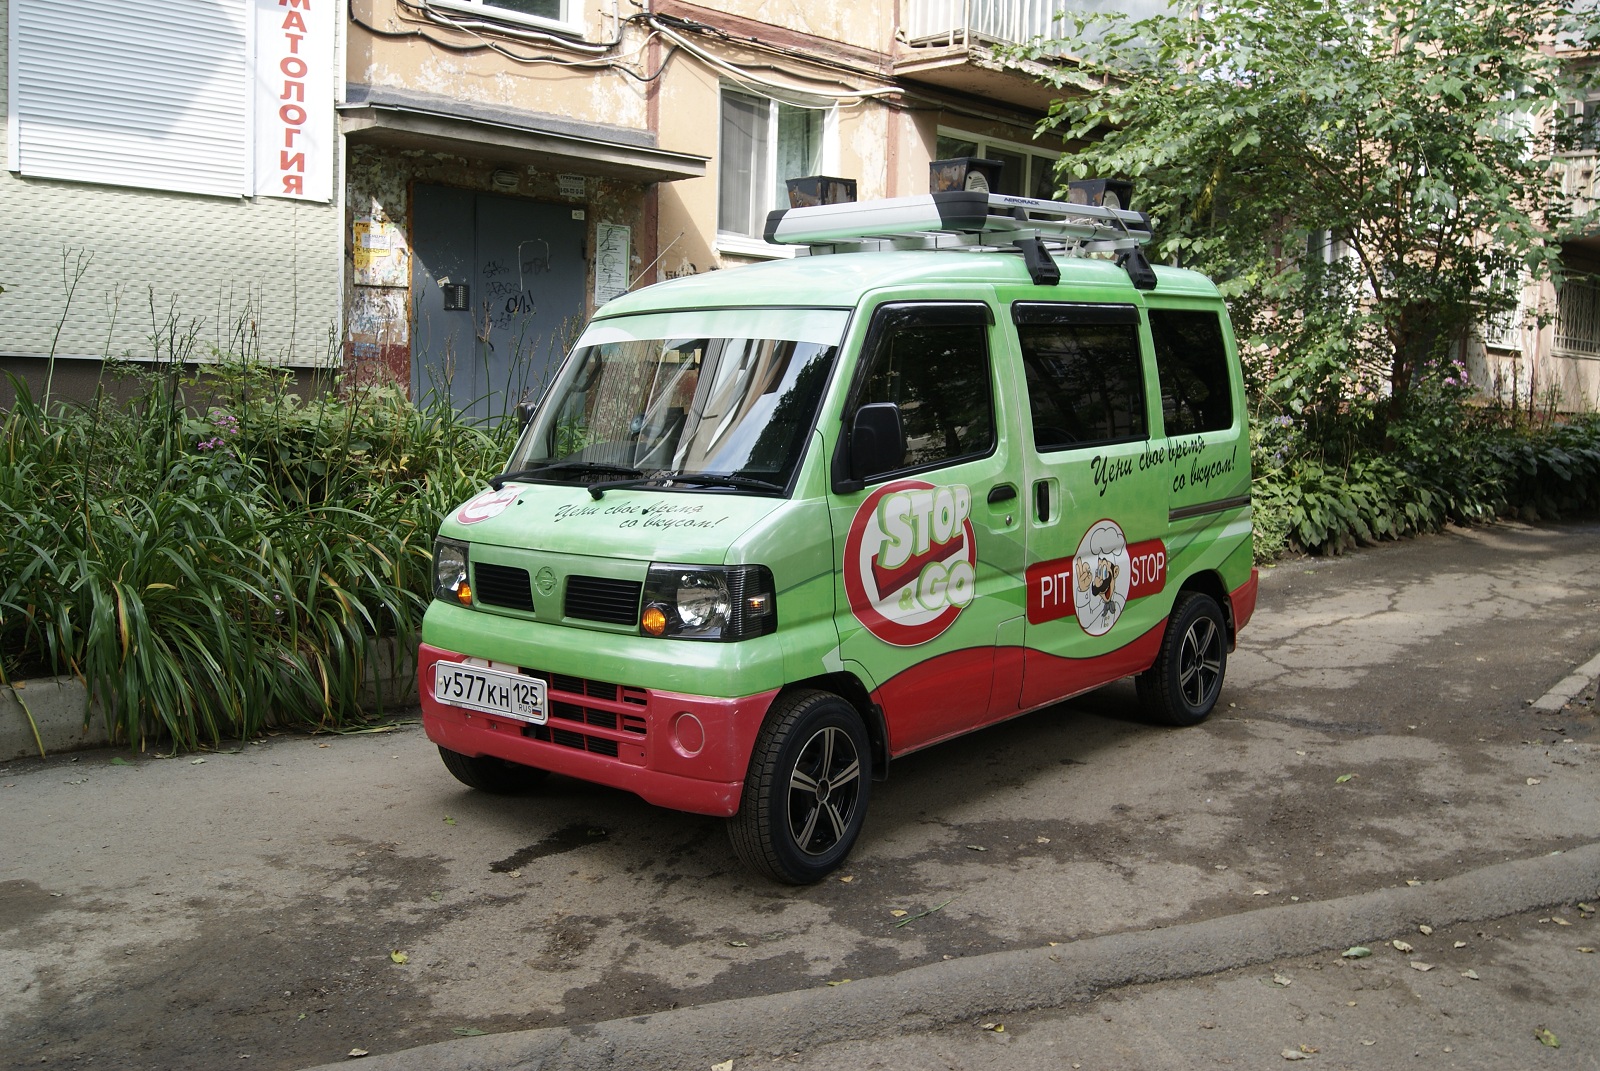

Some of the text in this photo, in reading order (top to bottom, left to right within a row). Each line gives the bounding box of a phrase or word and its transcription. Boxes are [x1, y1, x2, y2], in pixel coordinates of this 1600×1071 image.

[1004, 197, 1039, 205] AERORACK
[1091, 435, 1206, 497] Цени свое время
[1173, 445, 1237, 493] со вкусом!
[554, 500, 704, 523] Цени свое время
[619, 513, 729, 531] со вкусом!
[876, 484, 971, 570] STOP
[898, 560, 975, 611] & GO
[1040, 552, 1165, 608] PIT STOP
[513, 683, 538, 706] 125
[518, 703, 532, 713] RUS
